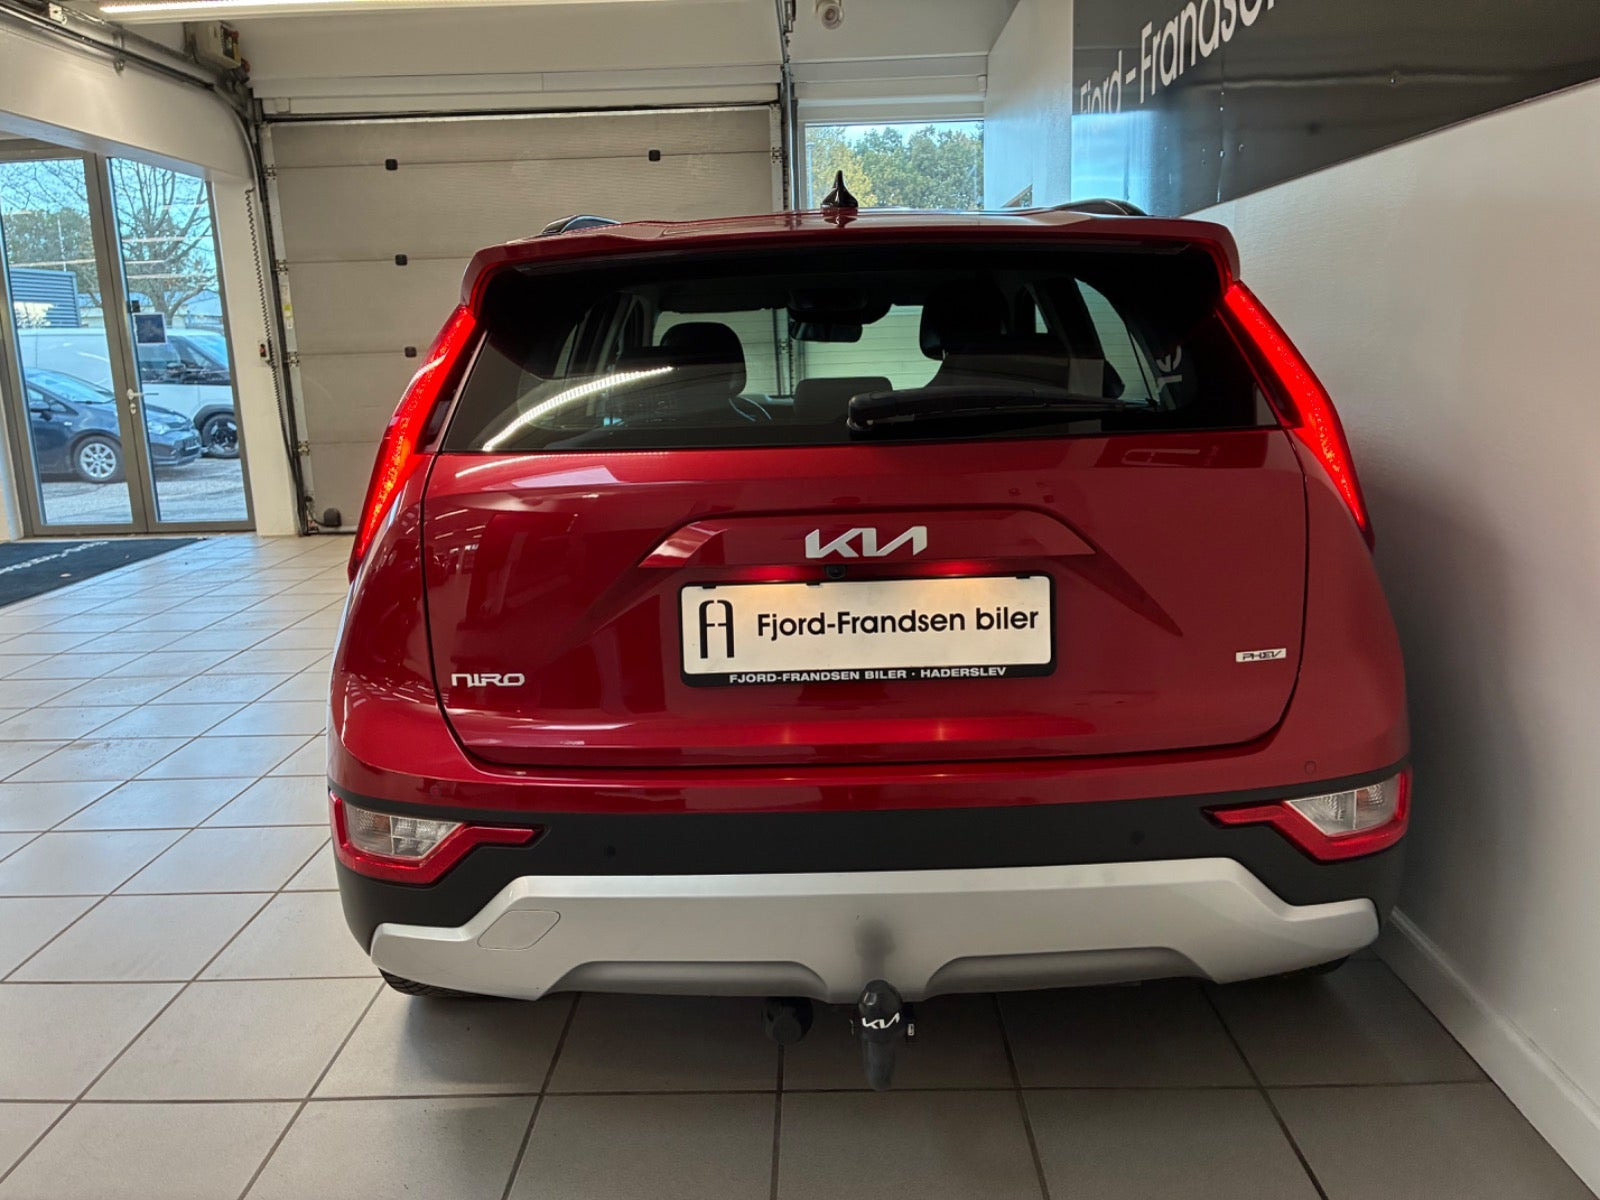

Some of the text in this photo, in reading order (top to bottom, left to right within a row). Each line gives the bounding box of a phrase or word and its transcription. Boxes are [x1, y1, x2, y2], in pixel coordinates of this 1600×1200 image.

[805, 526, 928, 558] KIA
[757, 607, 1039, 641] Fjord-Frandsen biler
[729, 667, 1007, 684] FJORD-FRANDSEN BILER HADERSLEV
[862, 1012, 900, 1029] KIA
